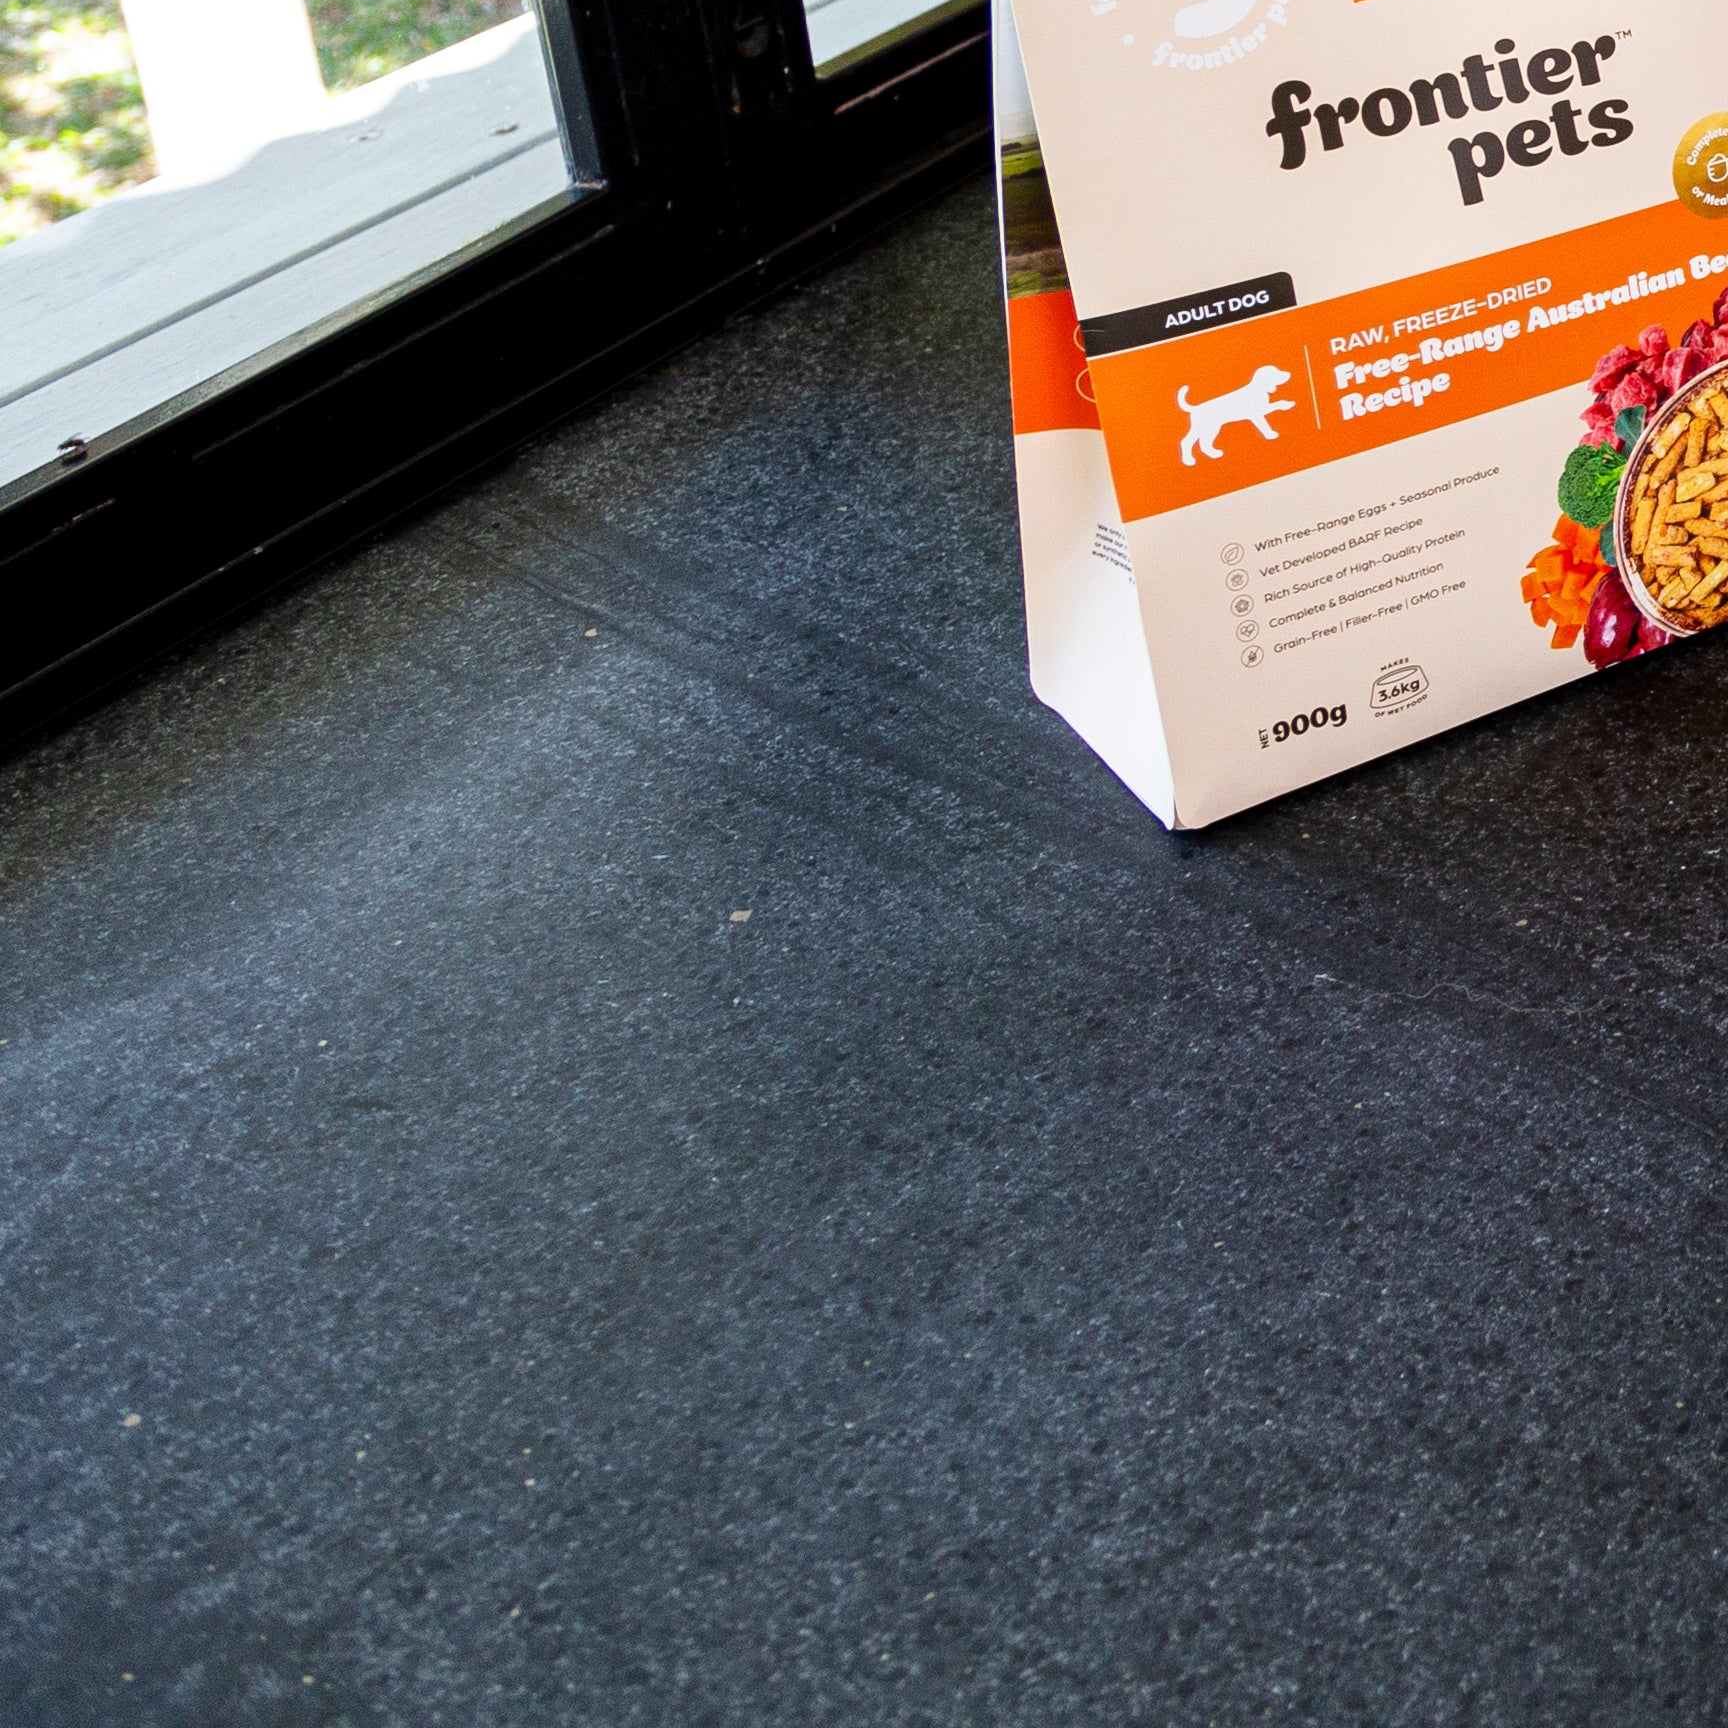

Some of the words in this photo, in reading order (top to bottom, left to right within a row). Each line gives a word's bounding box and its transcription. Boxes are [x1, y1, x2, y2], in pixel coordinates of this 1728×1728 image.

[1152, 22, 1268, 70] frontier
[1265, 35, 1616, 170] frontier
[1447, 99, 1634, 206] pets
[1691, 186, 1704, 198] or
[1164, 300, 1225, 329] ADULT
[1228, 290, 1270, 313] DOG
[1329, 325, 1391, 356] RAW,
[1392, 276, 1552, 338] FREEZE-DRIED
[1333, 318, 1521, 390] Free-Range
[1526, 266, 1686, 334] Australian
[1339, 372, 1451, 421] Recipe
[1254, 536, 1283, 552] With
[1284, 513, 1356, 543] Free-Range
[1357, 503, 1388, 519] Eggs
[1399, 480, 1452, 506] Seasonal
[1453, 466, 1500, 488] Produce
[1258, 563, 1281, 577] Vet
[1282, 542, 1347, 571] Developed
[1348, 529, 1382, 549] BARF
[1383, 518, 1423, 537] Recipe
[1264, 588, 1290, 604] Rich
[1292, 574, 1333, 594] Source
[1335, 566, 1347, 579] of
[1350, 543, 1423, 574] High-Quality
[1424, 529, 1466, 549] Protein
[1268, 603, 1326, 628] Complete
[1328, 598, 1337, 608] &
[1338, 578, 1394, 605] Balanced
[1395, 562, 1444, 586] Nutrition
[1273, 625, 1338, 653] Grain-Free
[1345, 603, 1403, 629] Filler-Free
[1410, 588, 1439, 606] GMO
[1441, 580, 1466, 595] Free
[1378, 679, 1420, 703] 3.6kg
[1380, 657, 1409, 671] MAKES
[1258, 728, 1270, 749] NET
[1272, 703, 1348, 743] 900g
